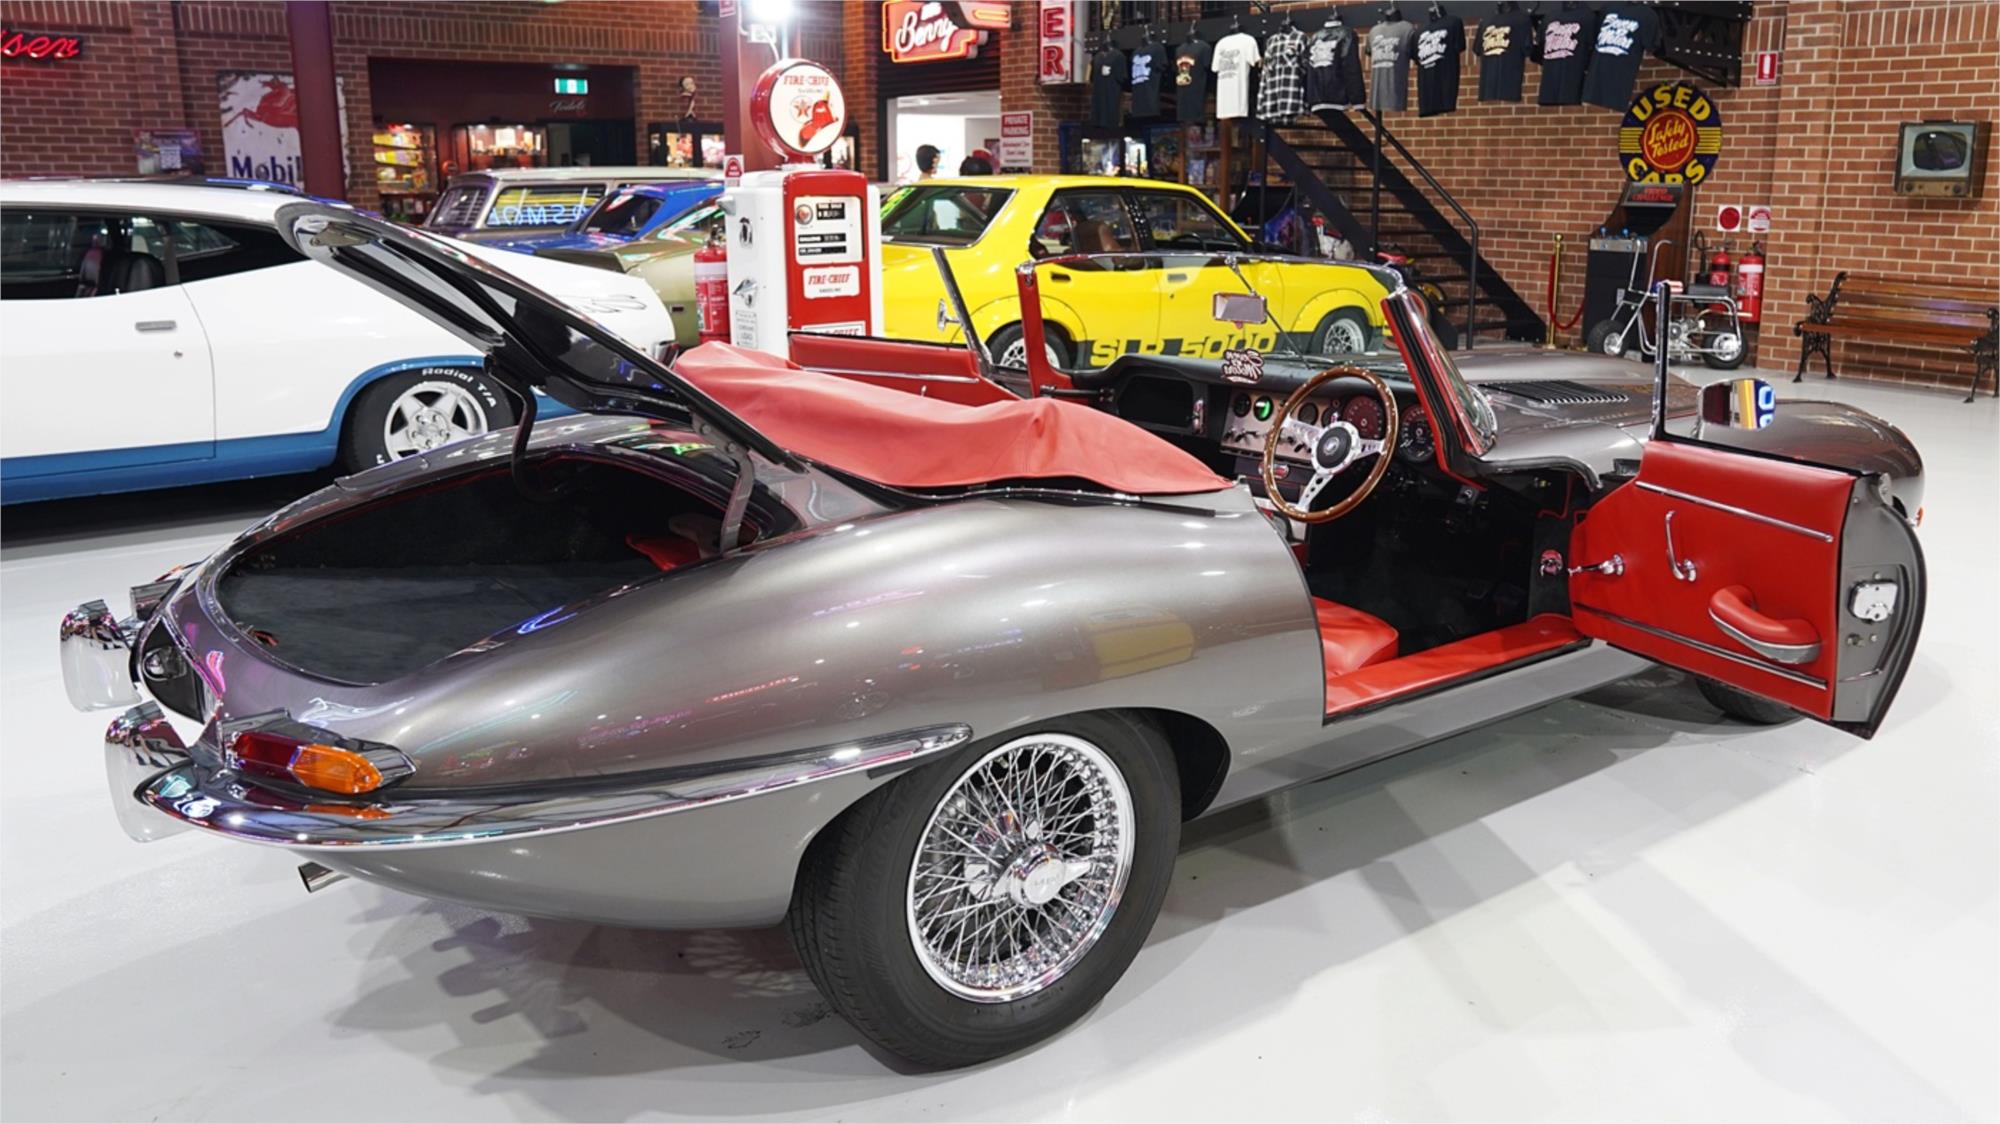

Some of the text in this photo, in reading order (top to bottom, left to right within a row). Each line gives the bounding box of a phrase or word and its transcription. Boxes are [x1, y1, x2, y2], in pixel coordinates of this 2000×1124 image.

[1631, 85, 1711, 122] USED
[1649, 119, 1686, 145] Safety
[1651, 133, 1689, 158] Tested
[231, 155, 304, 183] Mobil
[1178, 332, 1276, 359] 5000
[421, 367, 497, 408] Radial T/A
